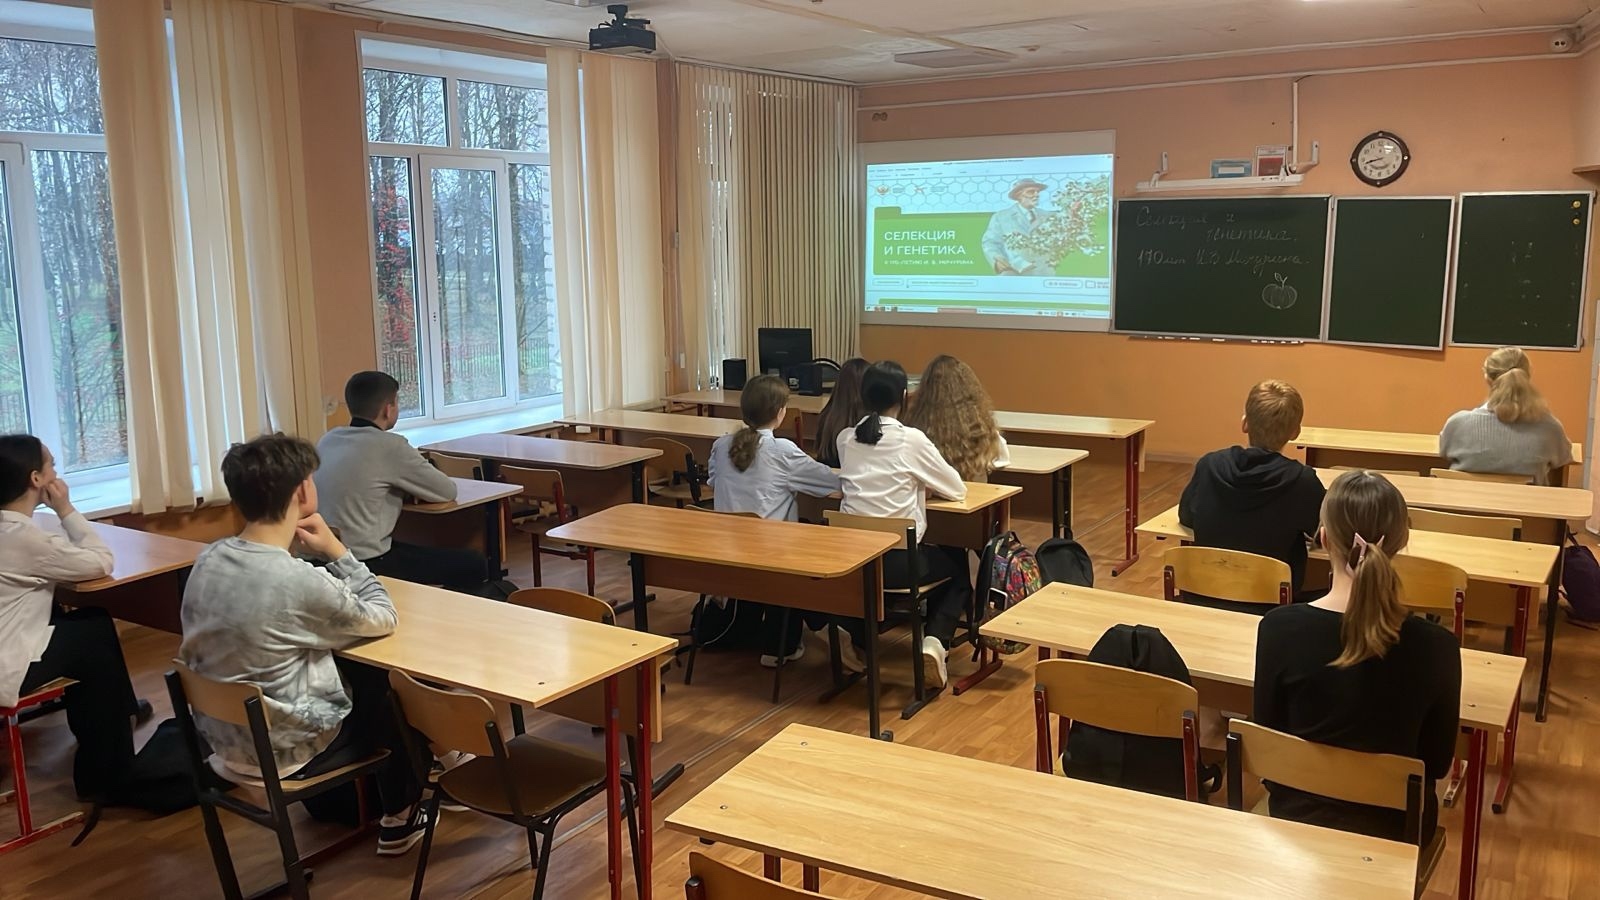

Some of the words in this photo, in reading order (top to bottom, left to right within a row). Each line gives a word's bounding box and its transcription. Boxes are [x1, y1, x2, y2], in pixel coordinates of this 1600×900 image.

[884, 230, 956, 242] СЕЛЕКЦИЯ
[884, 245, 894, 255] И
[897, 245, 967, 255] ГЕНЕТИКА
